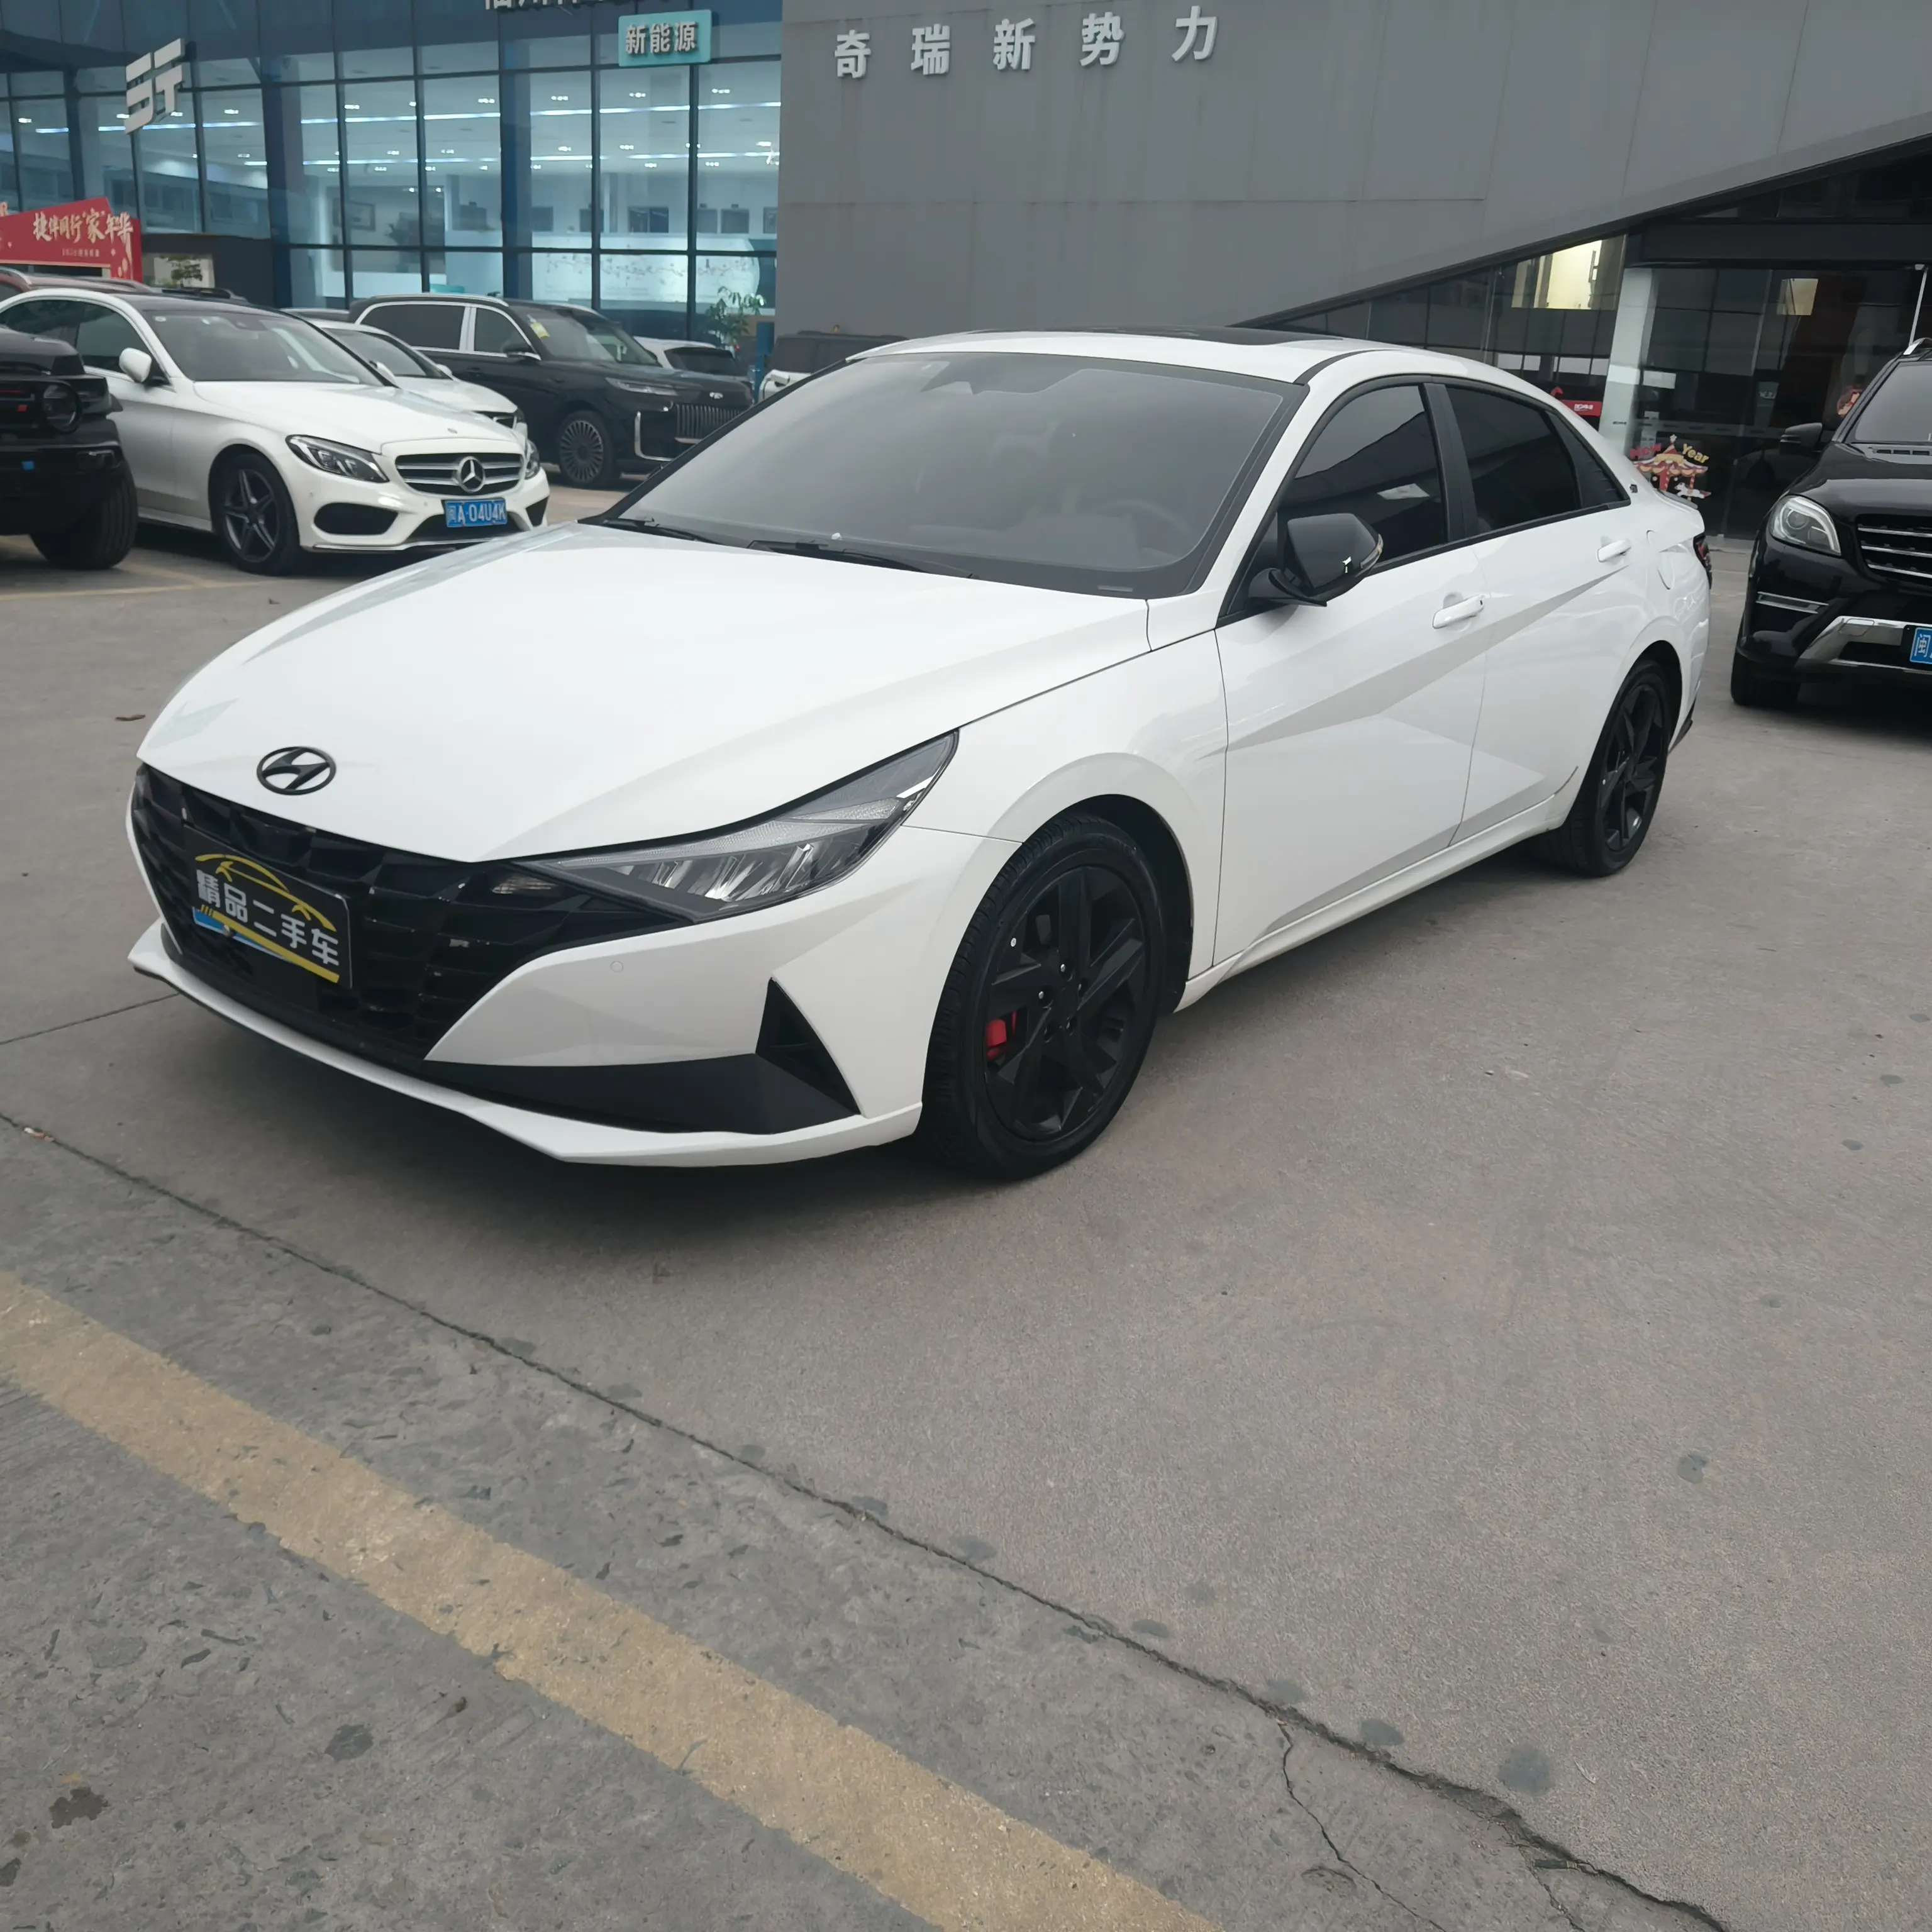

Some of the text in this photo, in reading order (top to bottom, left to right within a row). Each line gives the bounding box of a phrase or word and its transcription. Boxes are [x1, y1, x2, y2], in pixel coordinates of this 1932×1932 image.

[625, 21, 696, 54] 新能源
[835, 5, 1218, 79] 奇瑞新势力
[1682, 443, 1709, 464] Year
[1914, 633, 1932, 658] 闽
[196, 869, 339, 966] 精品二手车
